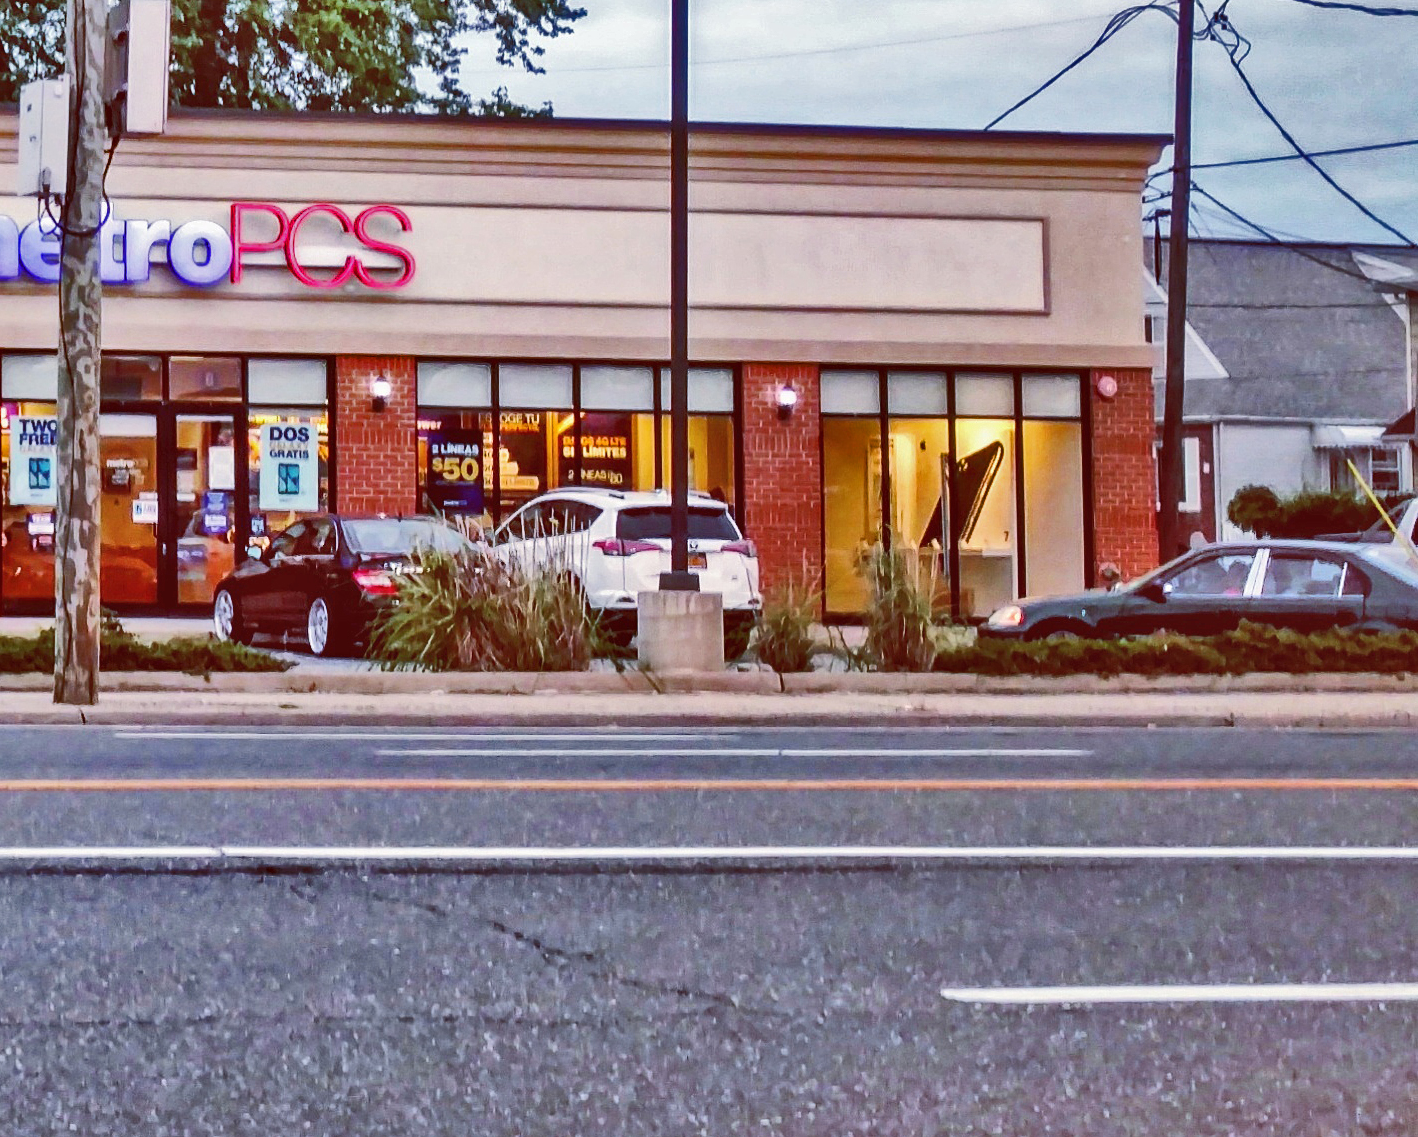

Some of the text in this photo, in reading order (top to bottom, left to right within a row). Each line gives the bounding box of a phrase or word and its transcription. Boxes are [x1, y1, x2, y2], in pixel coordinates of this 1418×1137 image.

[269, 426, 310, 443] DOS
[269, 449, 310, 460] GRATIS
[432, 457, 480, 481] $50
